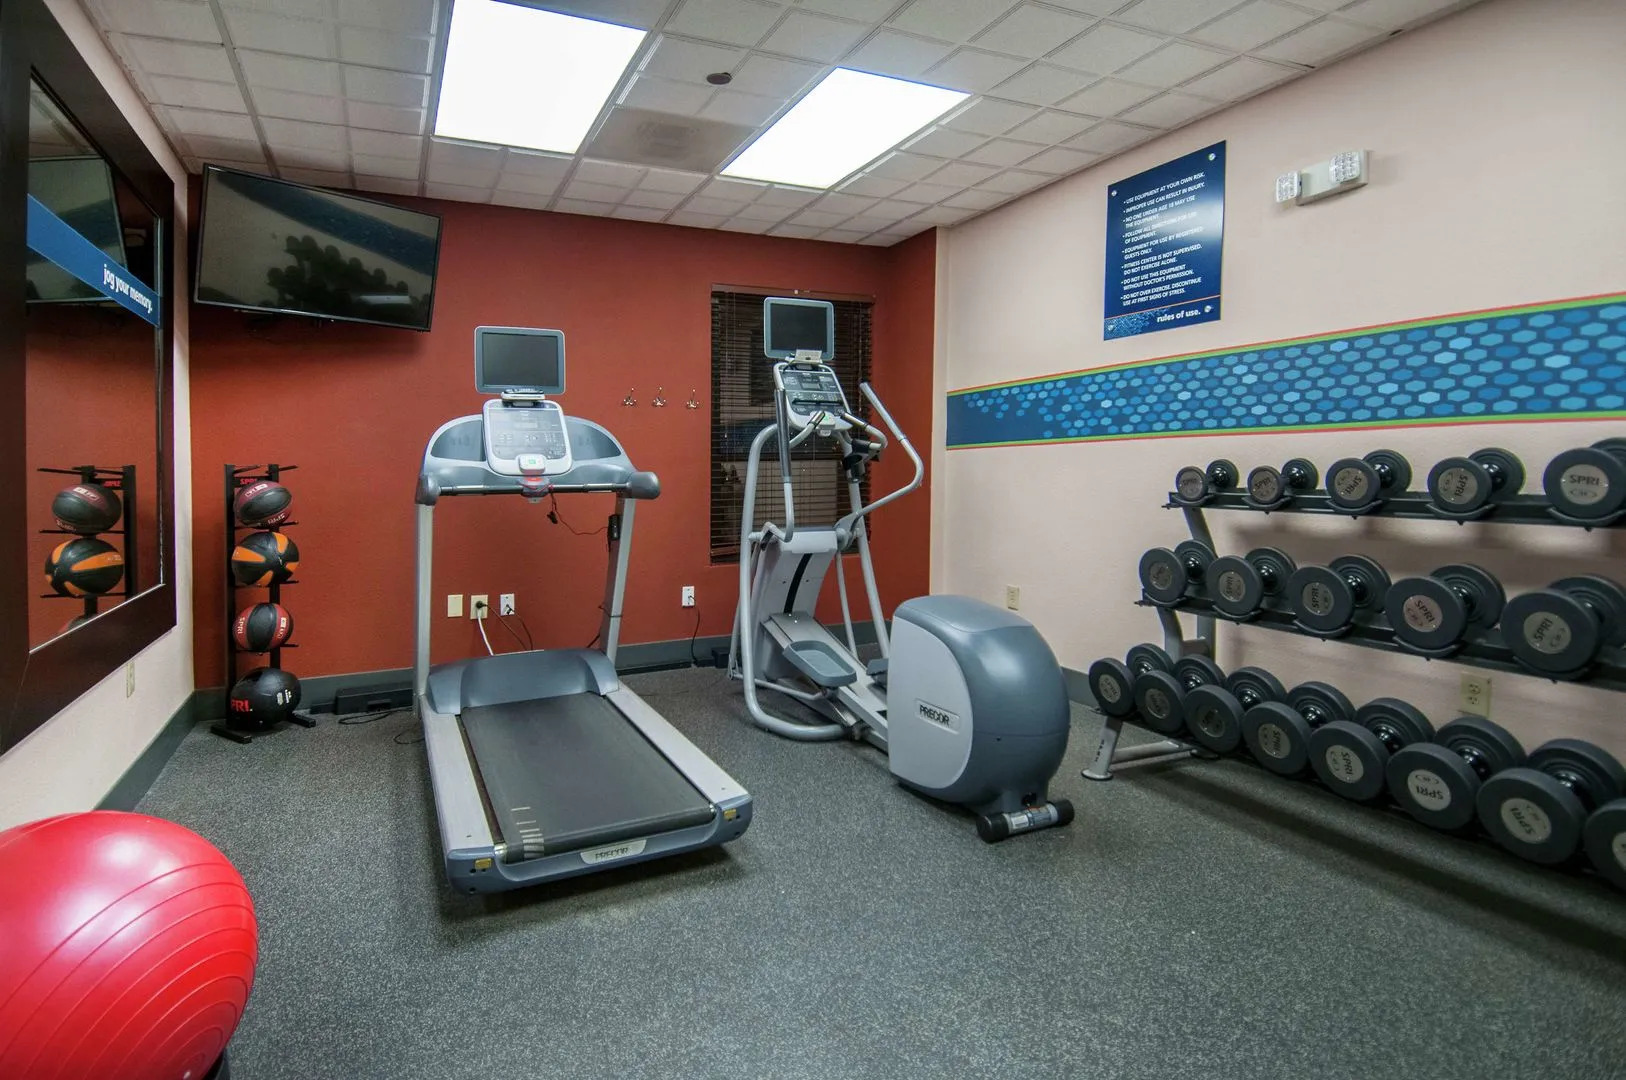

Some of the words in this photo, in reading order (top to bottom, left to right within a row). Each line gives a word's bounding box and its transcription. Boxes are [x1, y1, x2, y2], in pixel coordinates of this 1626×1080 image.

[1135, 188, 1159, 201] EQUIPMENT
[1167, 181, 1180, 190] YOUR
[1181, 176, 1192, 185] OWN
[1126, 202, 1146, 213] IMPROPER
[1166, 190, 1181, 199] RESULT
[1143, 208, 1158, 217] UNDER
[1125, 242, 1149, 253] EQUIPMENT
[1124, 252, 1140, 260] GUESTS
[1124, 261, 1140, 269] FITNESS
[1141, 256, 1157, 264] CENTER
[1141, 262, 1160, 271] EXERCISE
[1160, 265, 1186, 275] EQUIPMENT
[103, 263, 115, 290] jog
[115, 275, 130, 293] your
[129, 286, 153, 314] memory.
[1124, 282, 1143, 291] WITHOUT
[1144, 277, 1165, 286] DOCTOR'S
[1172, 278, 1202, 288] DISCONTINUE
[1157, 313, 1174, 322] rules
[1346, 475, 1362, 495] SPRI
[1454, 474, 1468, 497] SPRI
[1569, 474, 1600, 486] SPRI
[1311, 587, 1320, 608] SPRI
[1415, 599, 1435, 623] SPRI
[237, 616, 246, 634] SPRI
[1534, 617, 1553, 641] SPRI
[919, 704, 949, 728] PRECOR
[1341, 751, 1354, 775] SPRI
[1416, 785, 1444, 800] SPRI
[1510, 807, 1536, 835] SPRI
[595, 847, 629, 860] PRECOR
